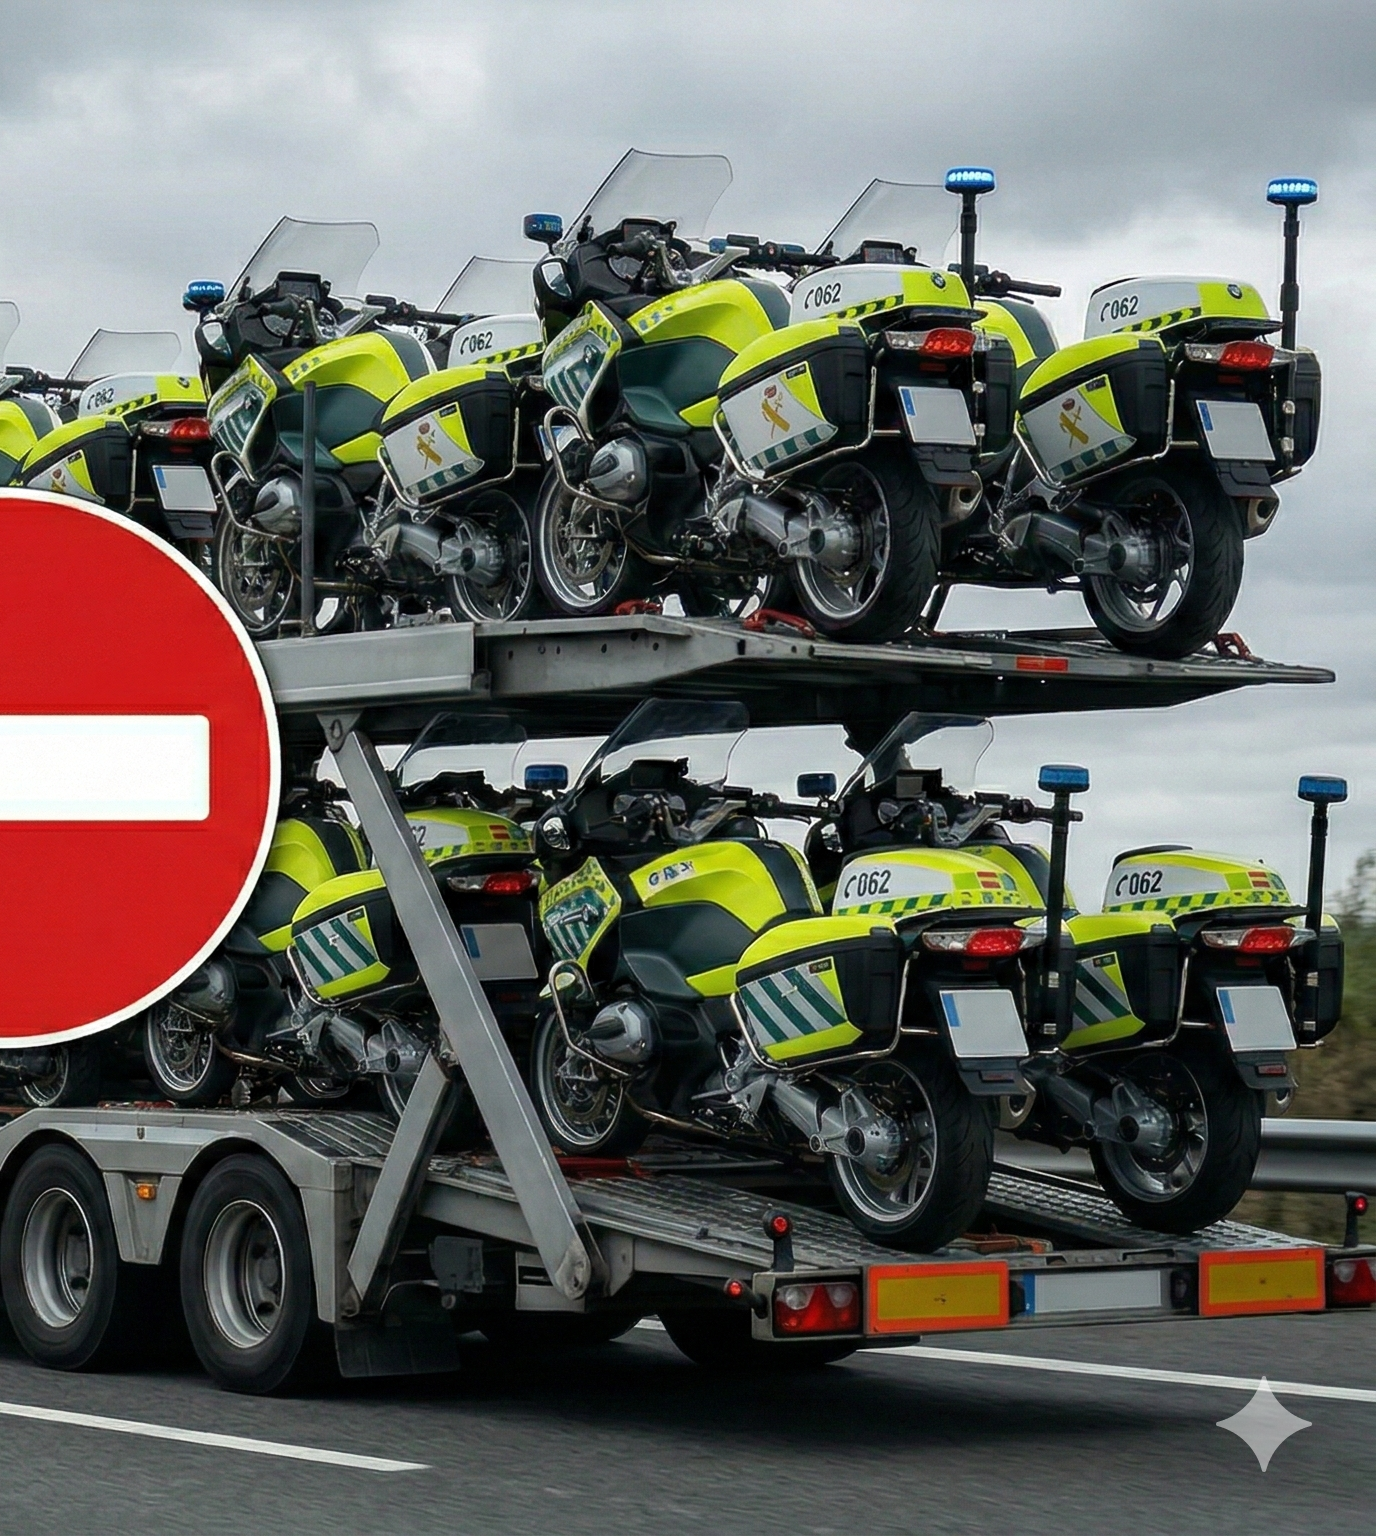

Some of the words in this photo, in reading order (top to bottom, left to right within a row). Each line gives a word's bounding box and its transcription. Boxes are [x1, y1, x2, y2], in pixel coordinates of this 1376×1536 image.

[814, 283, 841, 307] 062
[1109, 296, 1138, 320] 062
[469, 331, 492, 353] 062
[857, 870, 891, 897] 062
[1128, 870, 1162, 895] 062
